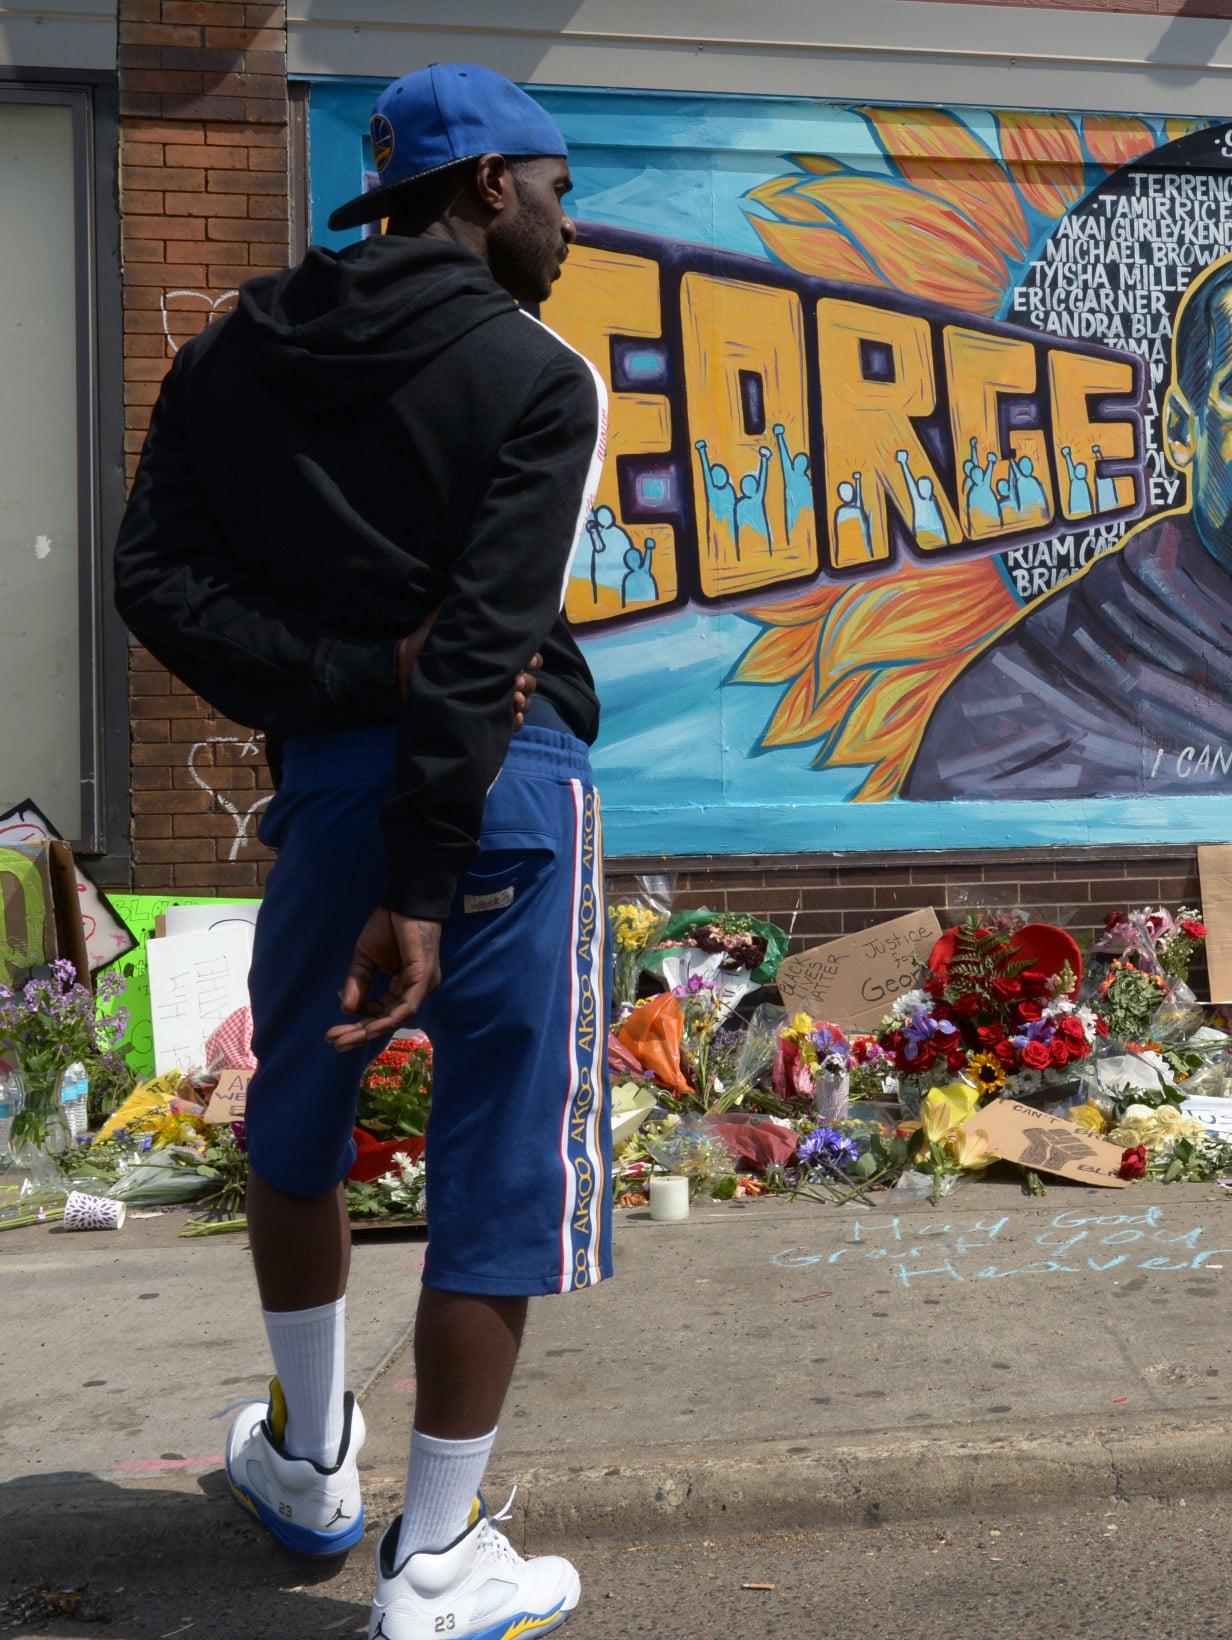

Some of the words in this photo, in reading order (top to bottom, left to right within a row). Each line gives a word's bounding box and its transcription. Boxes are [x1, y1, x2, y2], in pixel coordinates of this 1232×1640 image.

[1099, 195, 1174, 221] TAMIR
[1175, 199, 1232, 223] RICE
[1056, 215, 1106, 240] AKAI
[1110, 218, 1183, 243] GURLEY
[1046, 238, 1147, 264] MICHAEL
[1030, 261, 1111, 291] TYISHA
[1014, 287, 1066, 312] ERIC
[1068, 288, 1170, 316] GARNER
[1030, 311, 1125, 338] SANDRA
[548, 235, 1143, 632] EORGE
[1150, 748, 1164, 778] I
[582, 793, 594, 870] AKOO
[578, 883, 596, 961] AKOO
[861, 967, 922, 1002] Geor
[578, 974, 594, 1053] AKOO
[570, 1066, 594, 1144] AKOO
[574, 1157, 593, 1234] AKOO
[1051, 1205, 1165, 1229] God
[574, 1248, 588, 1289] OO
[434, 1612, 456, 1633] 23
